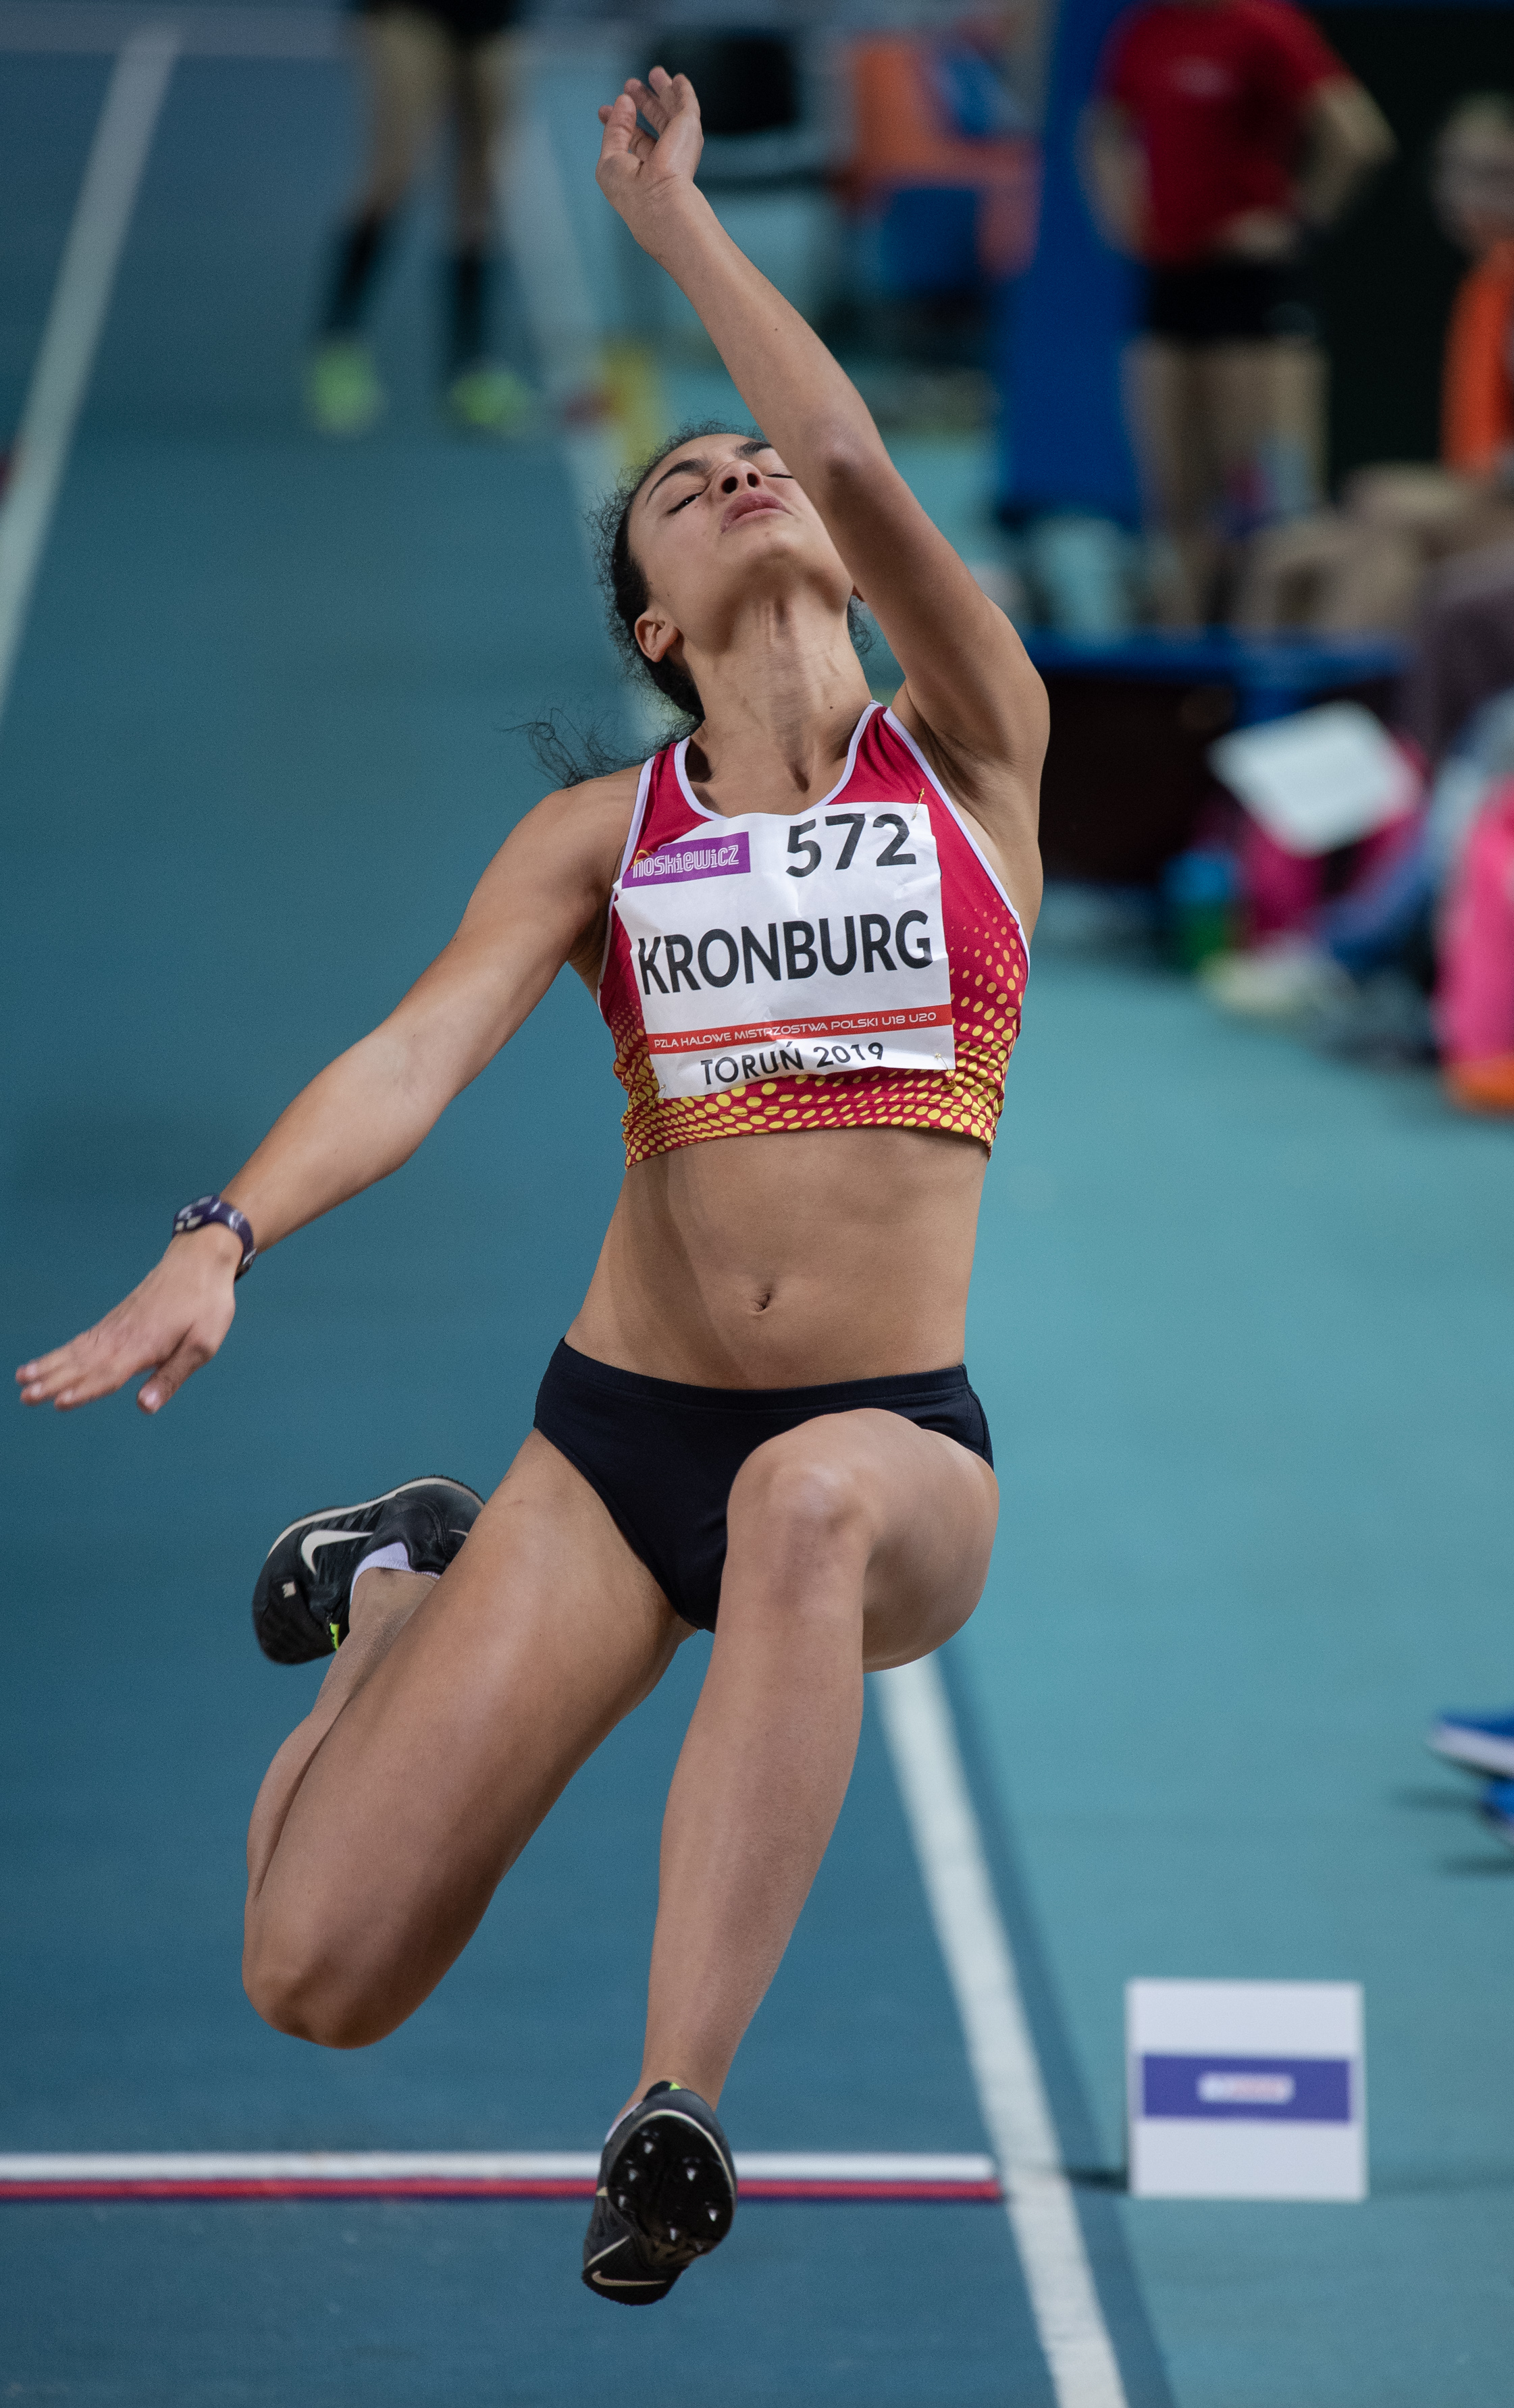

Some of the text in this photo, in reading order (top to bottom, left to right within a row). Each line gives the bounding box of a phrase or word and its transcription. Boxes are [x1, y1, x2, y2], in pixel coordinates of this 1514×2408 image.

[785, 813, 917, 878] 572
[637, 909, 933, 995] KRONBURG
[654, 1012, 937, 1048] PZLA HALOWE MISTRZOSTWA POLSKI U18 U20
[700, 1041, 883, 1085] TORUŃ 2019
